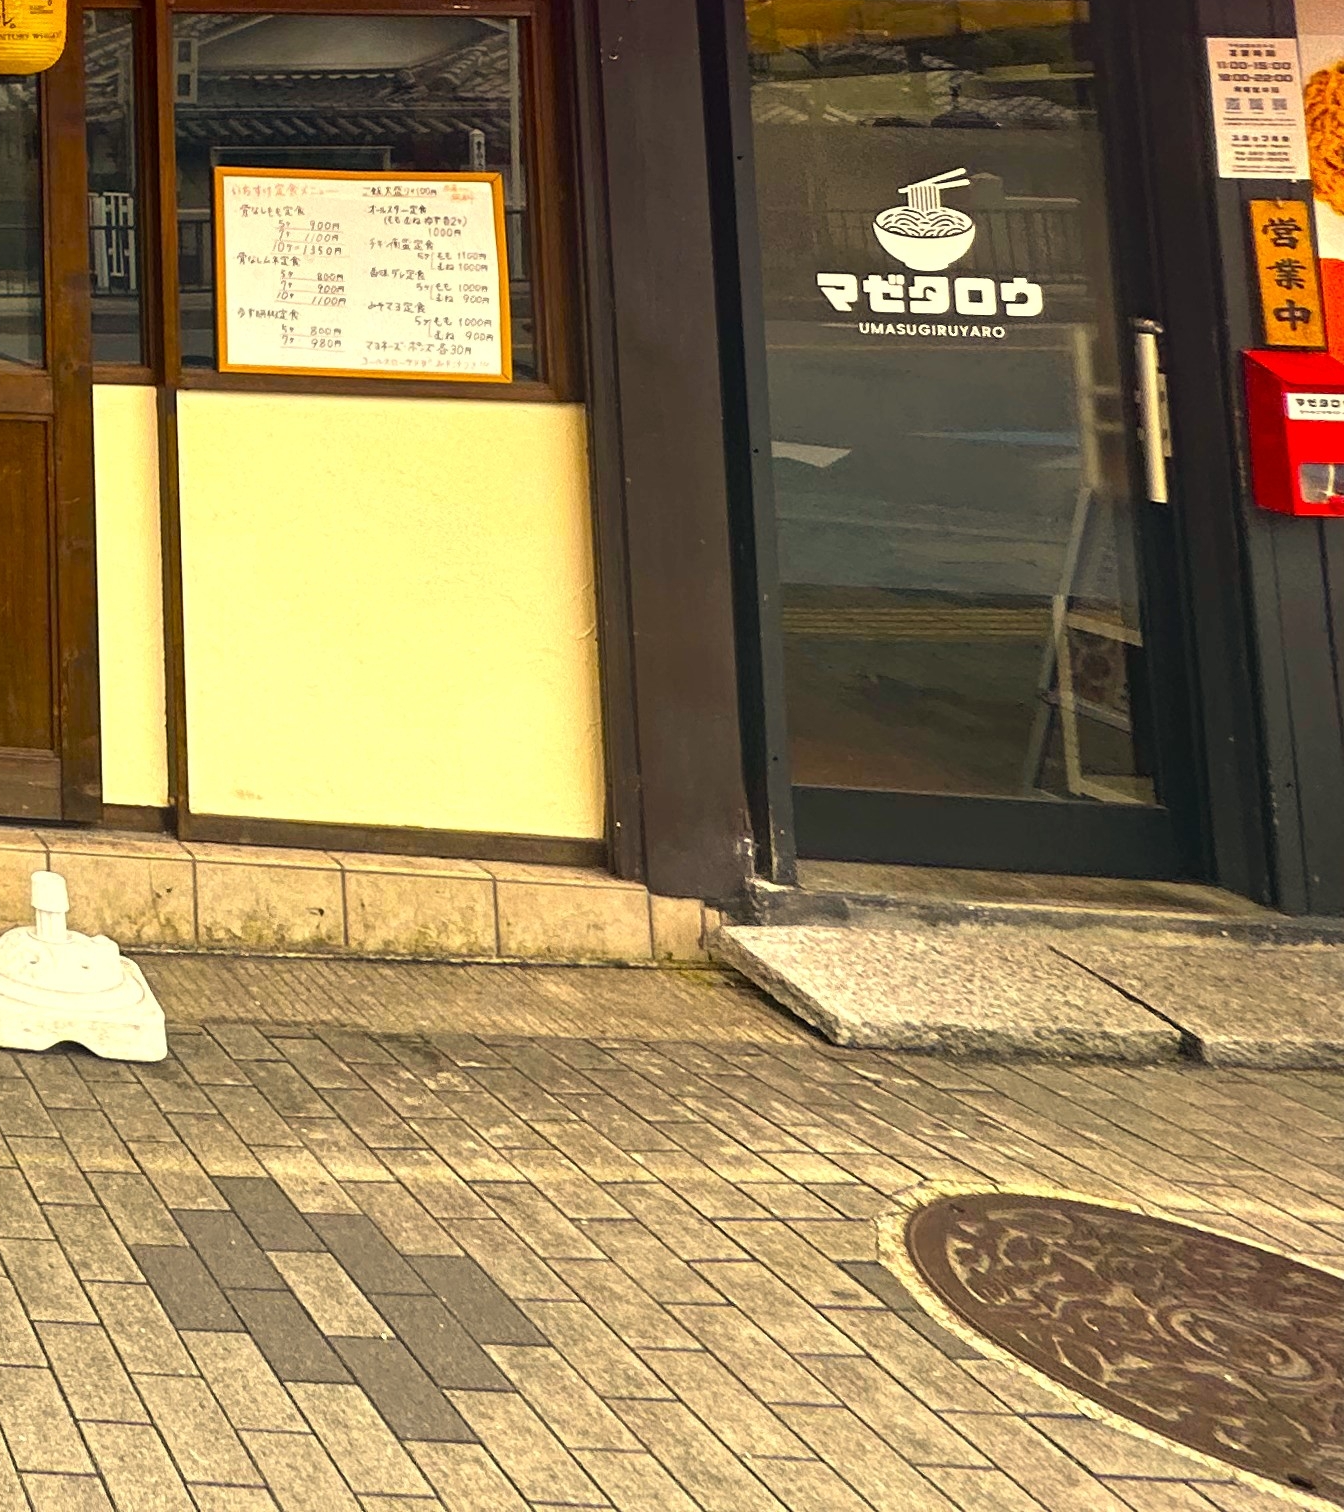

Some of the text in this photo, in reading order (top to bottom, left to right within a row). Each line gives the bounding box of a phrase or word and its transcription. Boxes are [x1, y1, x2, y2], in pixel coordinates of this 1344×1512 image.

[816, 272, 1044, 318] マゼタロウ
[1261, 215, 1312, 332] 営業中
[858, 322, 1007, 340] UMASUGIRUYARO
